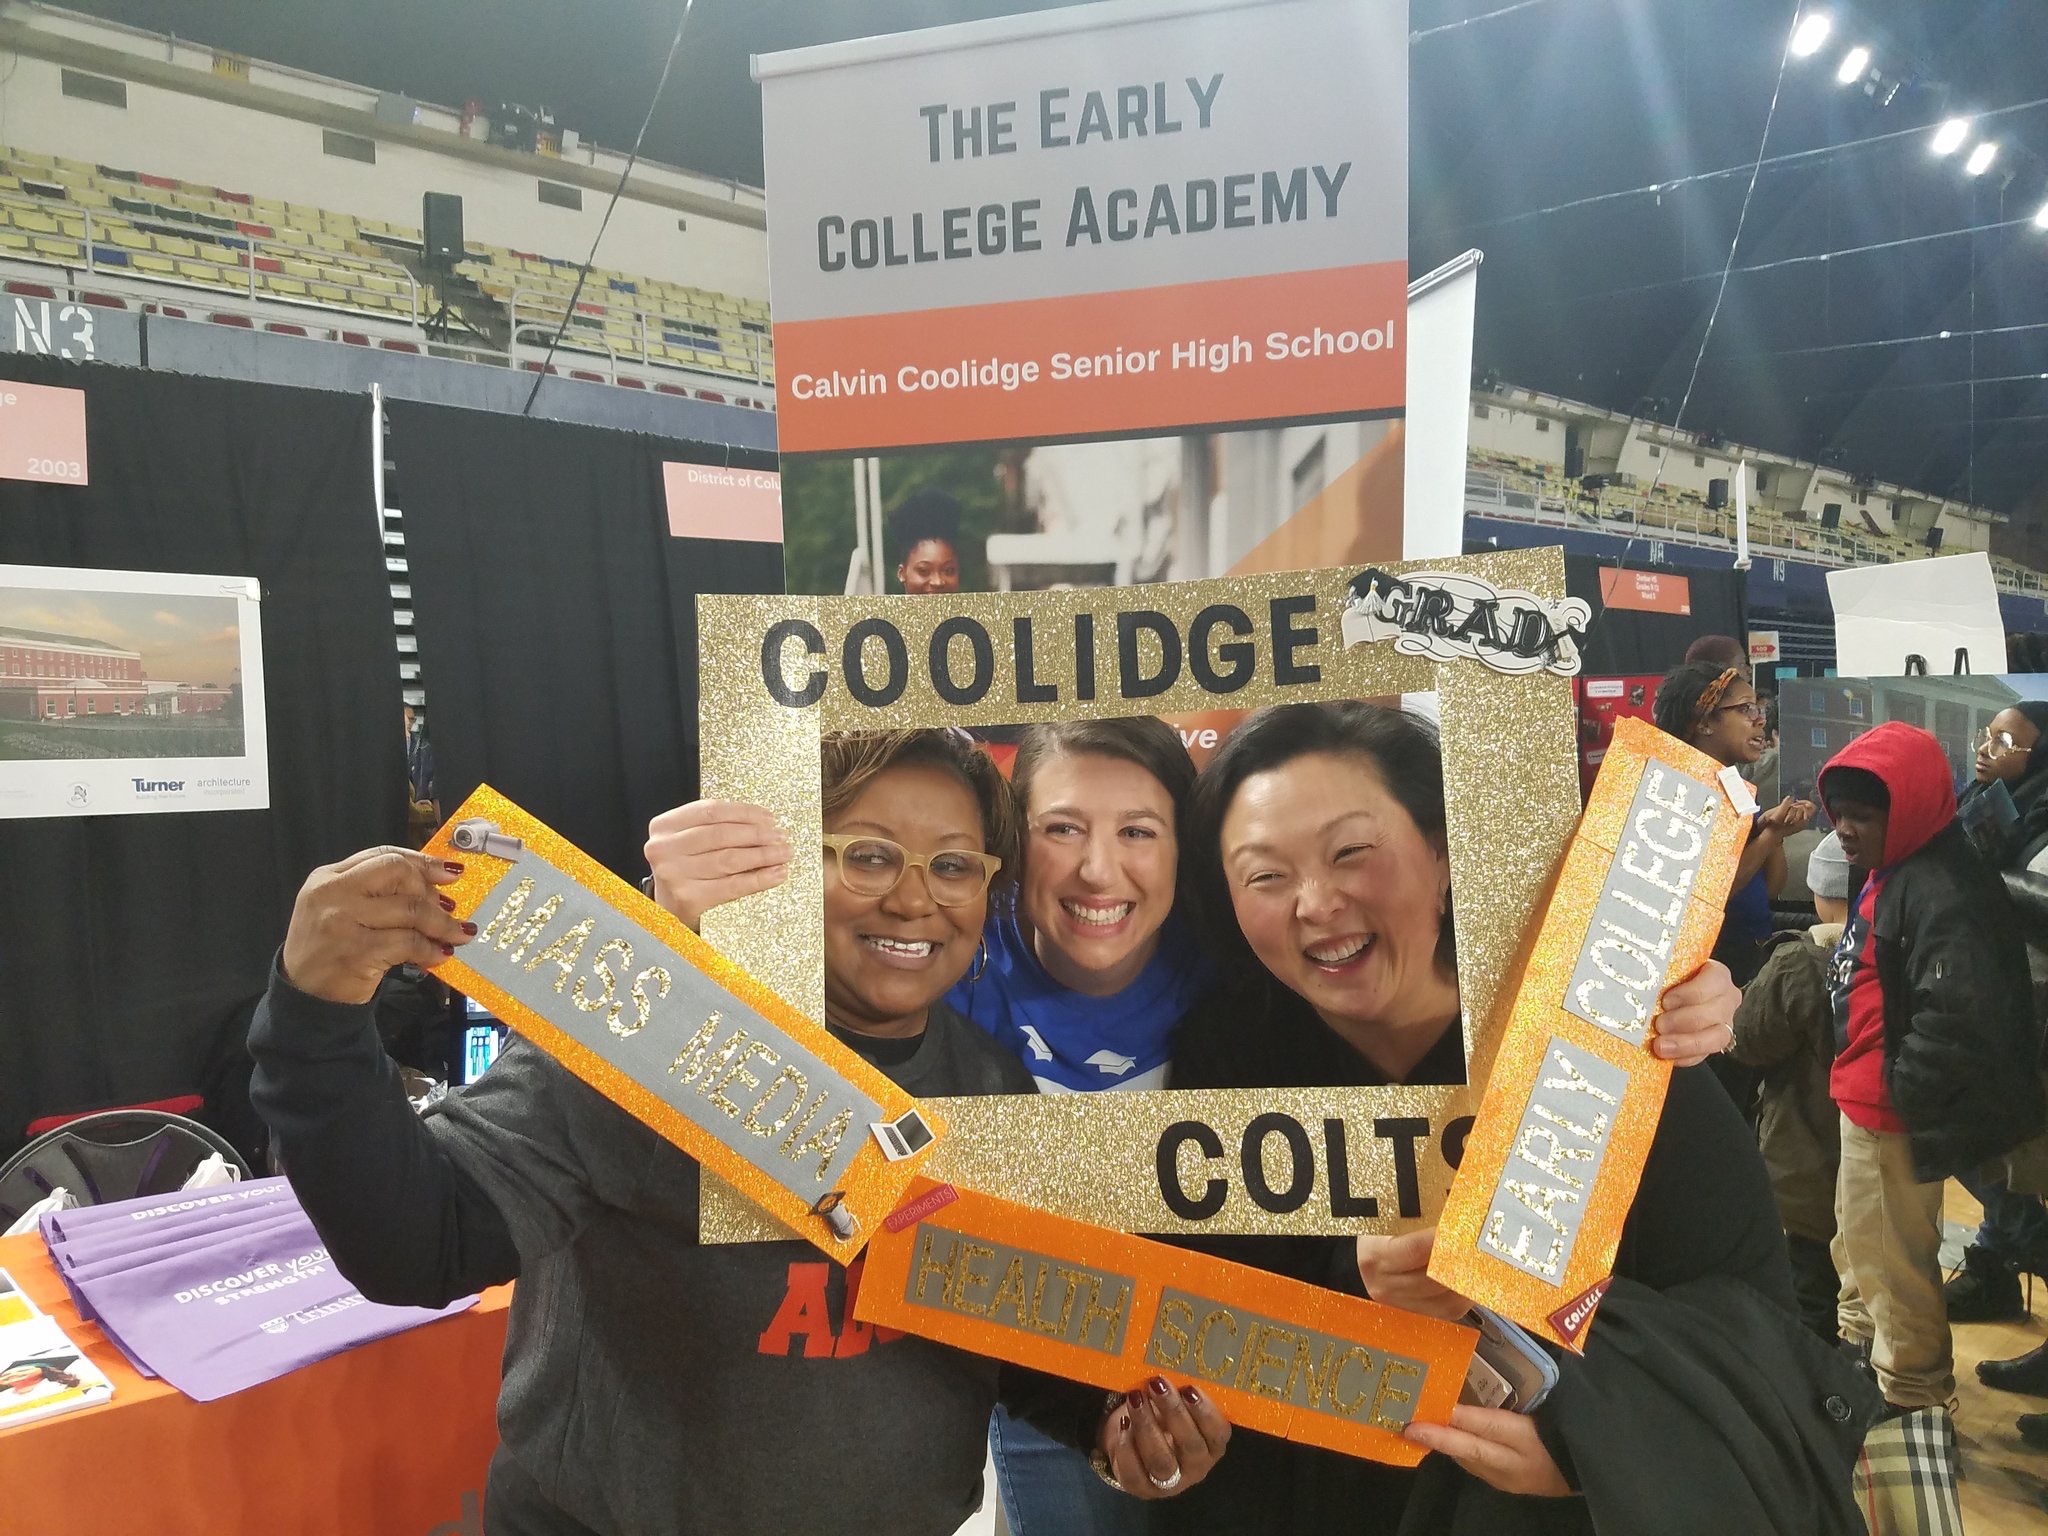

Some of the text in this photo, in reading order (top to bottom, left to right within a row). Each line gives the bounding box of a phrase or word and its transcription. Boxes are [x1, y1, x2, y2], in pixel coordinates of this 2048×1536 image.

[1040, 73, 1225, 149] EARLY
[817, 162, 1352, 272] COLLEGE ACADEMY
[15, 298, 95, 361] N3
[791, 320, 1395, 400] Calvin Coolidge Senior High School
[27, 458, 81, 478] 2003
[688, 470, 734, 486] District
[738, 475, 751, 487] of
[761, 595, 1322, 709] COOLIDGE
[131, 778, 185, 792] Turner
[197, 777, 251, 787] architecture
[478, 876, 853, 1181] MASS MEDIA
[1485, 767, 1716, 1277] EARLY COLLEGE
[131, 1193, 234, 1221] DISCOVER
[886, 1187, 953, 1229] EXPERIMENTS
[174, 1263, 281, 1304] DISCOVER
[214, 1265, 326, 1306] STRENGTH
[1564, 1288, 1603, 1331] COLLEGE
[914, 1233, 1131, 1352] HEALTH
[1153, 1298, 1420, 1430] SCIENCE
